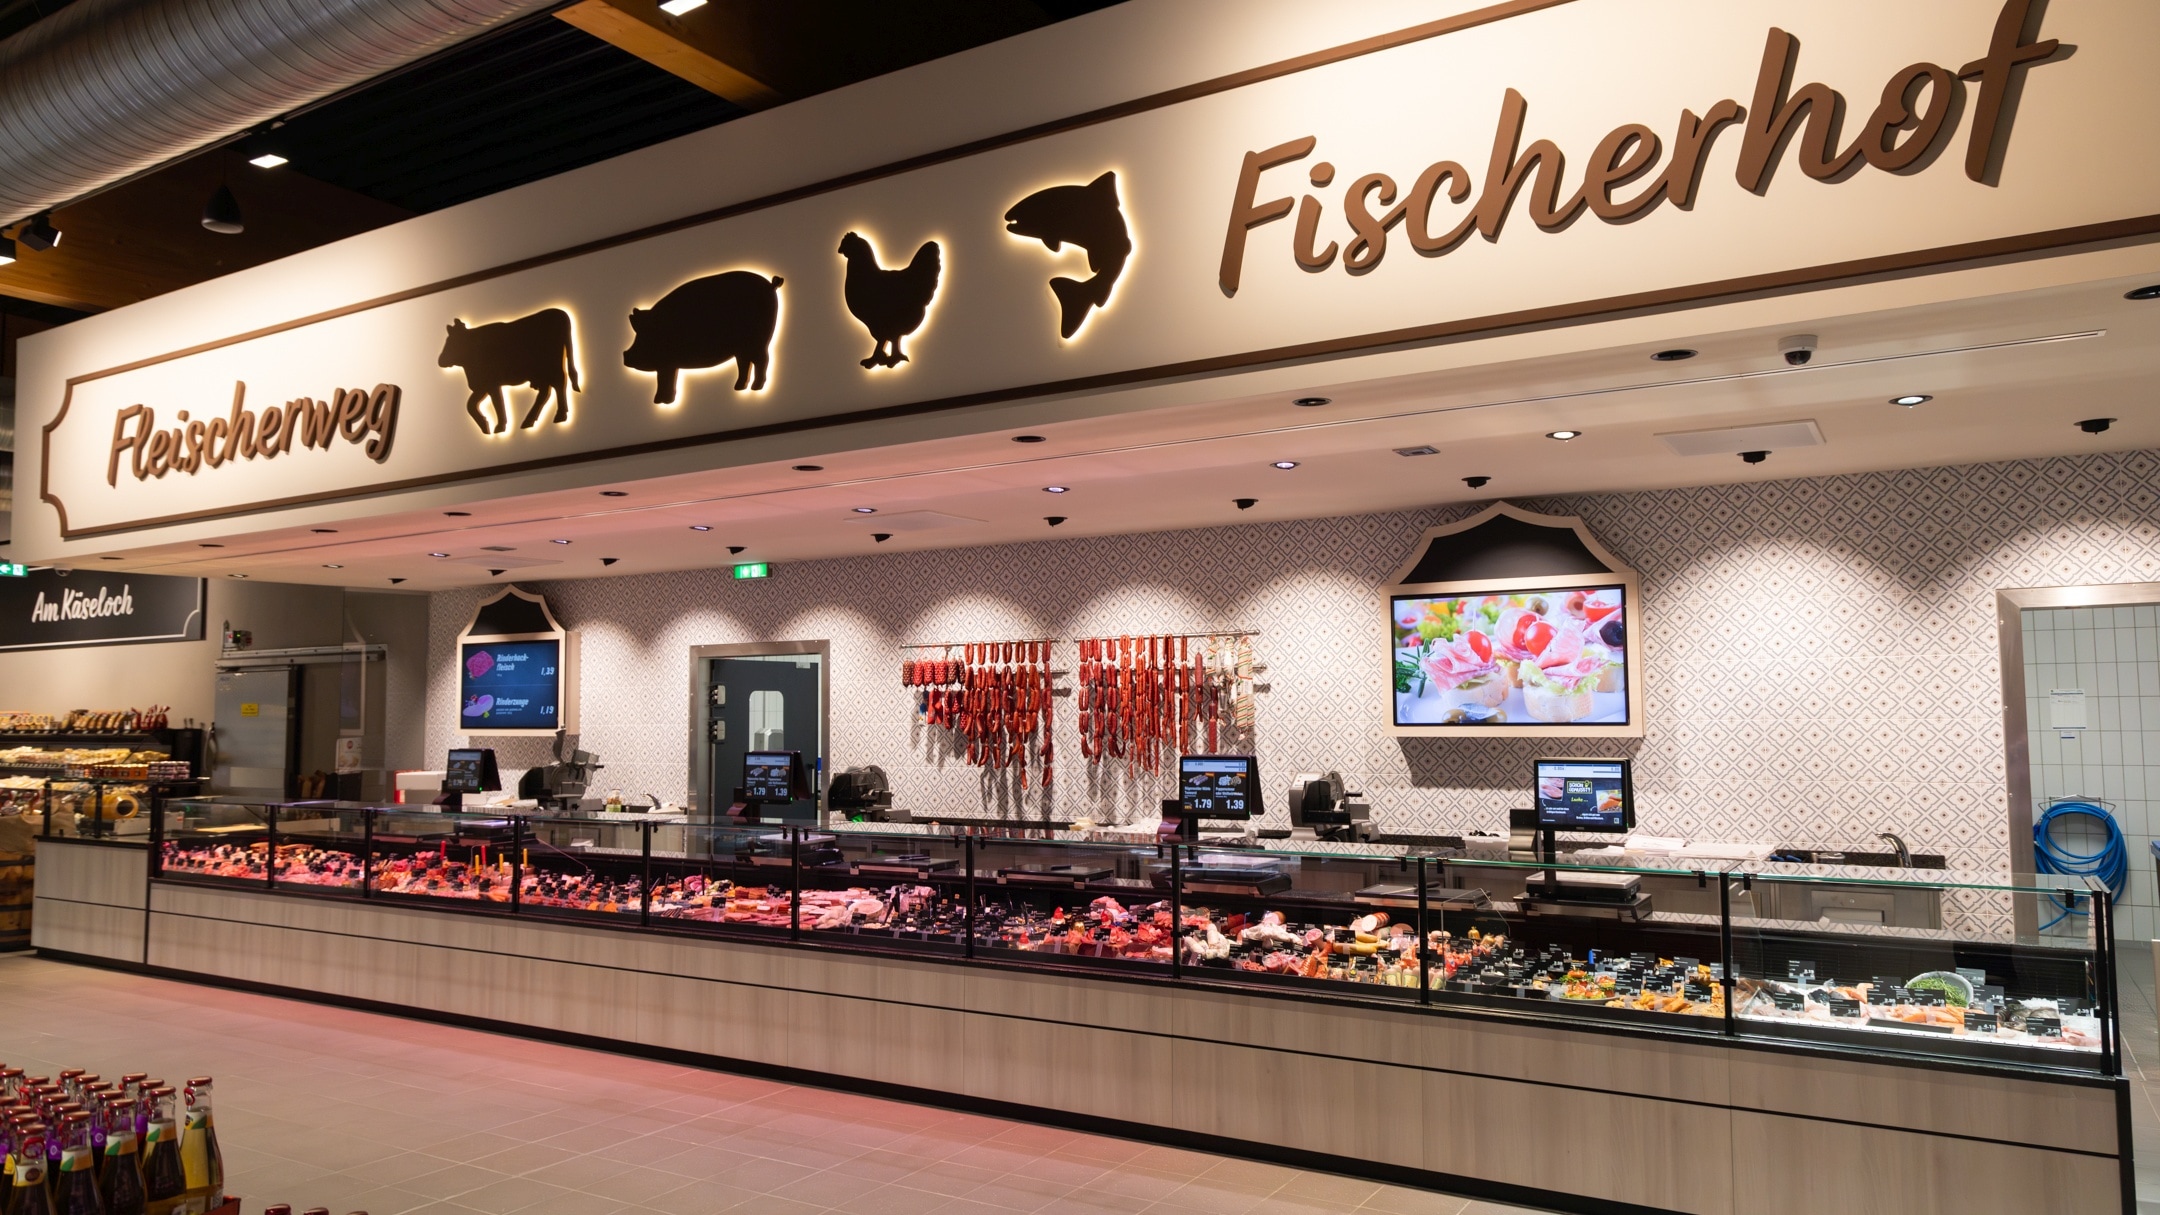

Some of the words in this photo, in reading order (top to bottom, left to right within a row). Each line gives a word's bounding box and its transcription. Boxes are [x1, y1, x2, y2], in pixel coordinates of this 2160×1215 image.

[1218, 0, 2064, 296] Fischerhof
[107, 380, 402, 489] Fleischerweg
[32, 591, 59, 623] Am
[60, 584, 134, 621] Käseloch
[496, 653, 529, 663] Rinderhack-
[496, 662, 515, 671] fleisch
[541, 666, 555, 676] 1,39
[495, 697, 529, 708] Rinderzunge
[540, 706, 554, 715] 1,19
[753, 787, 766, 796] 1.79
[775, 788, 788, 796] 1.39
[1194, 798, 1212, 809] 1.79
[1226, 799, 1244, 810] 1.39
